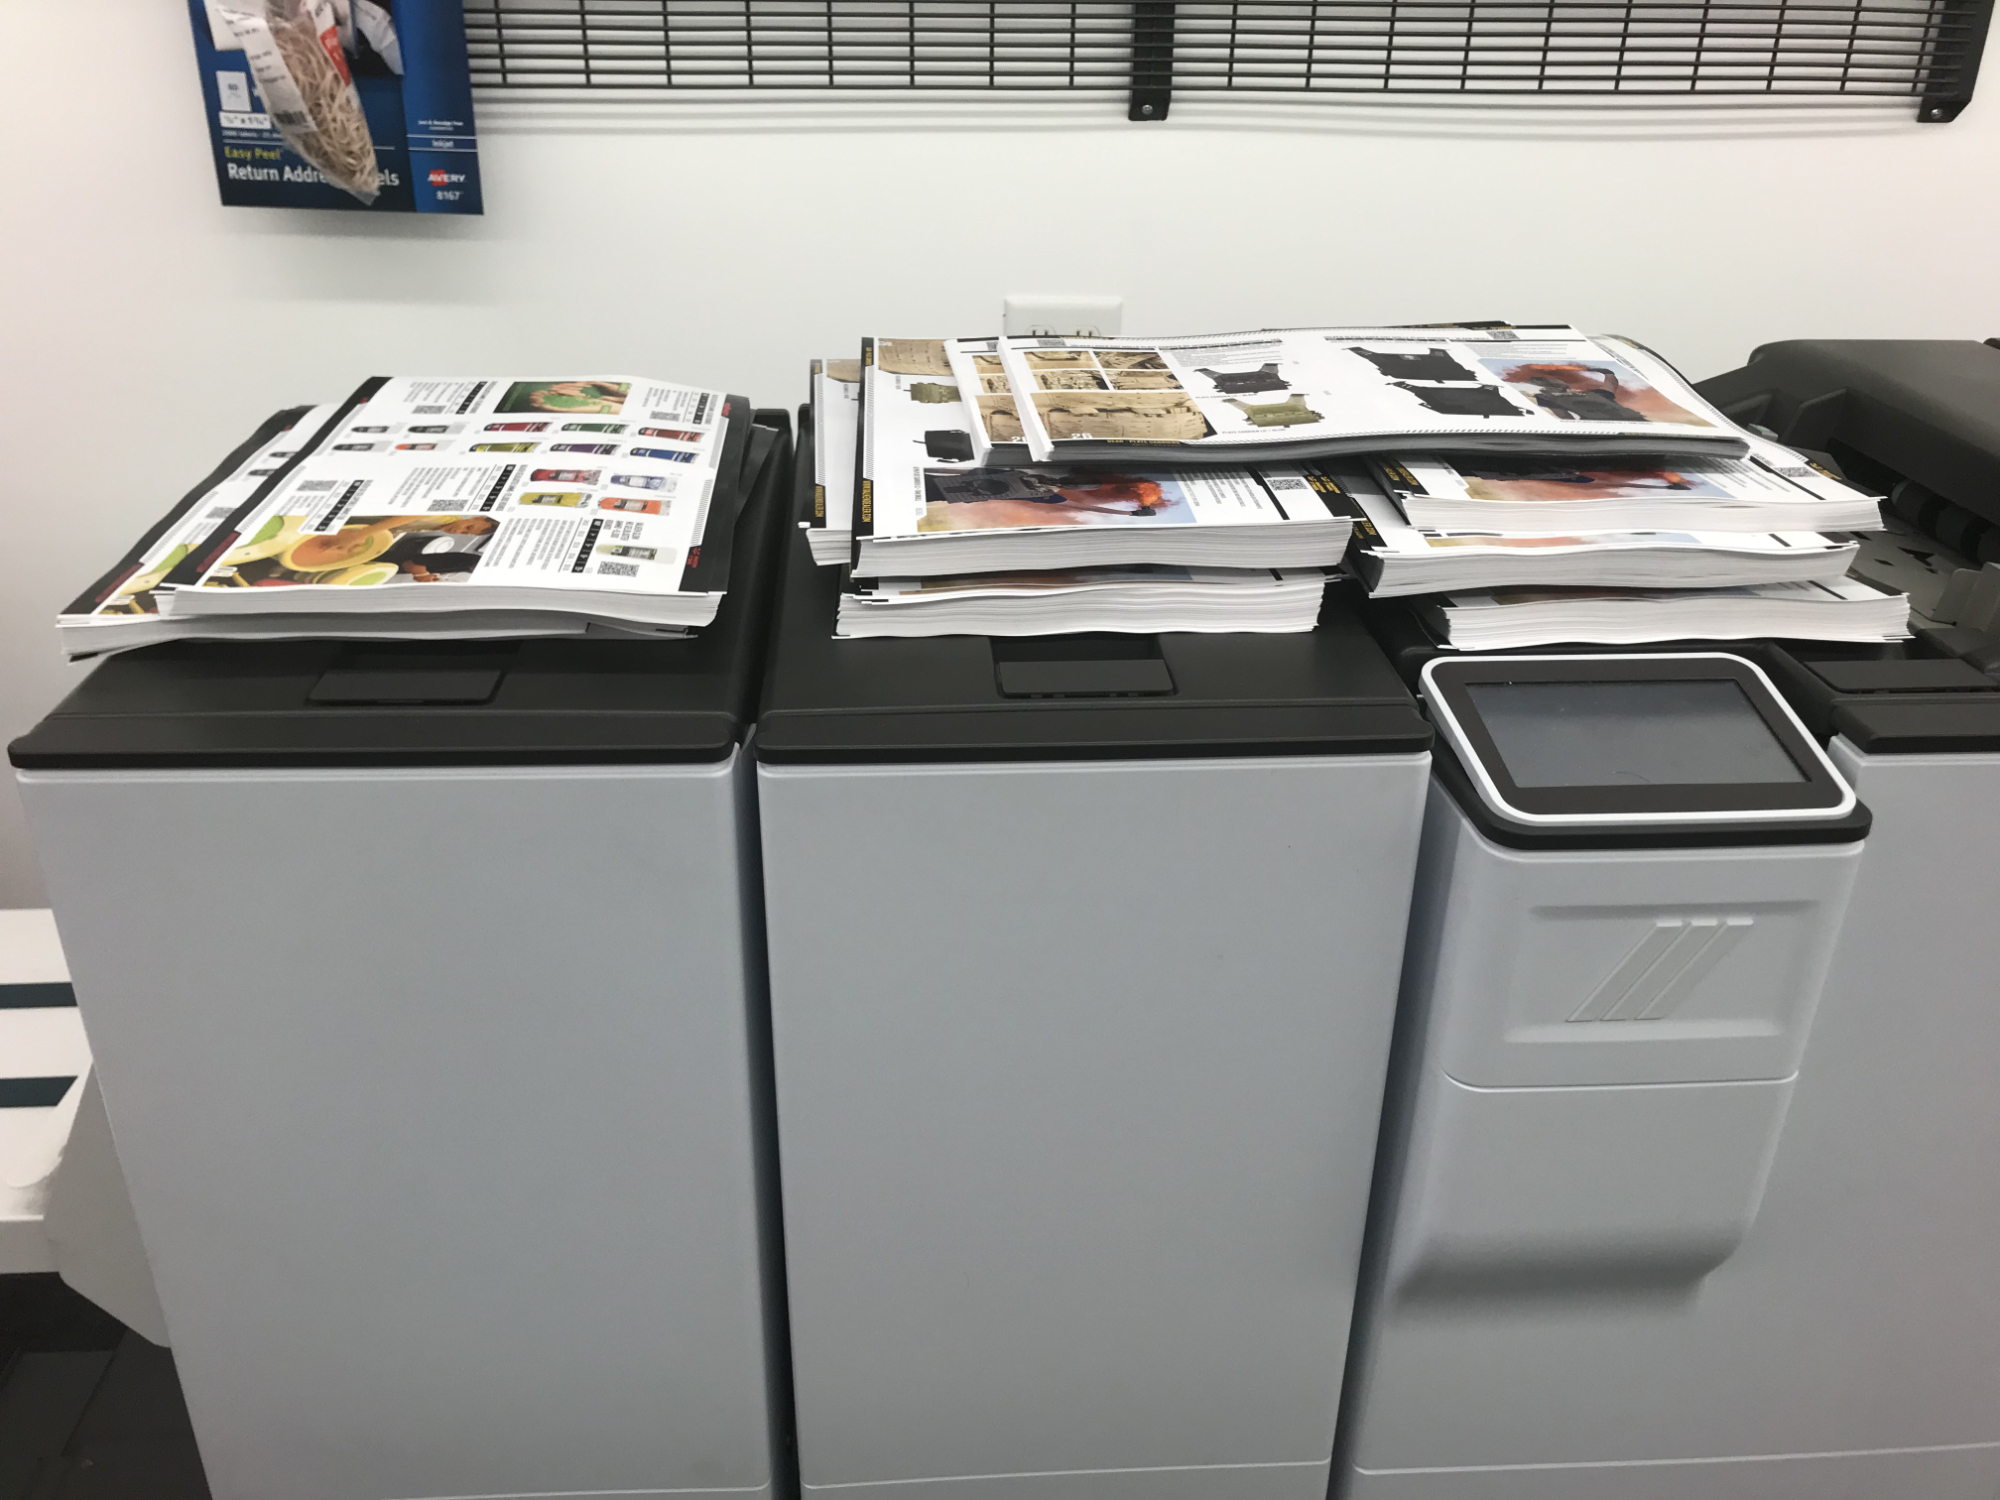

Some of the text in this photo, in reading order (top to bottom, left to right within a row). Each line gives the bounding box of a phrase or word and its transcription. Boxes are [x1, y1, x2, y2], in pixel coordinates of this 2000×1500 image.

[224, 146, 281, 161] Easy Peel
[227, 162, 280, 181] Return
[283, 164, 326, 183] Addre
[427, 173, 466, 183] AVERY
[436, 190, 460, 201] 8167
